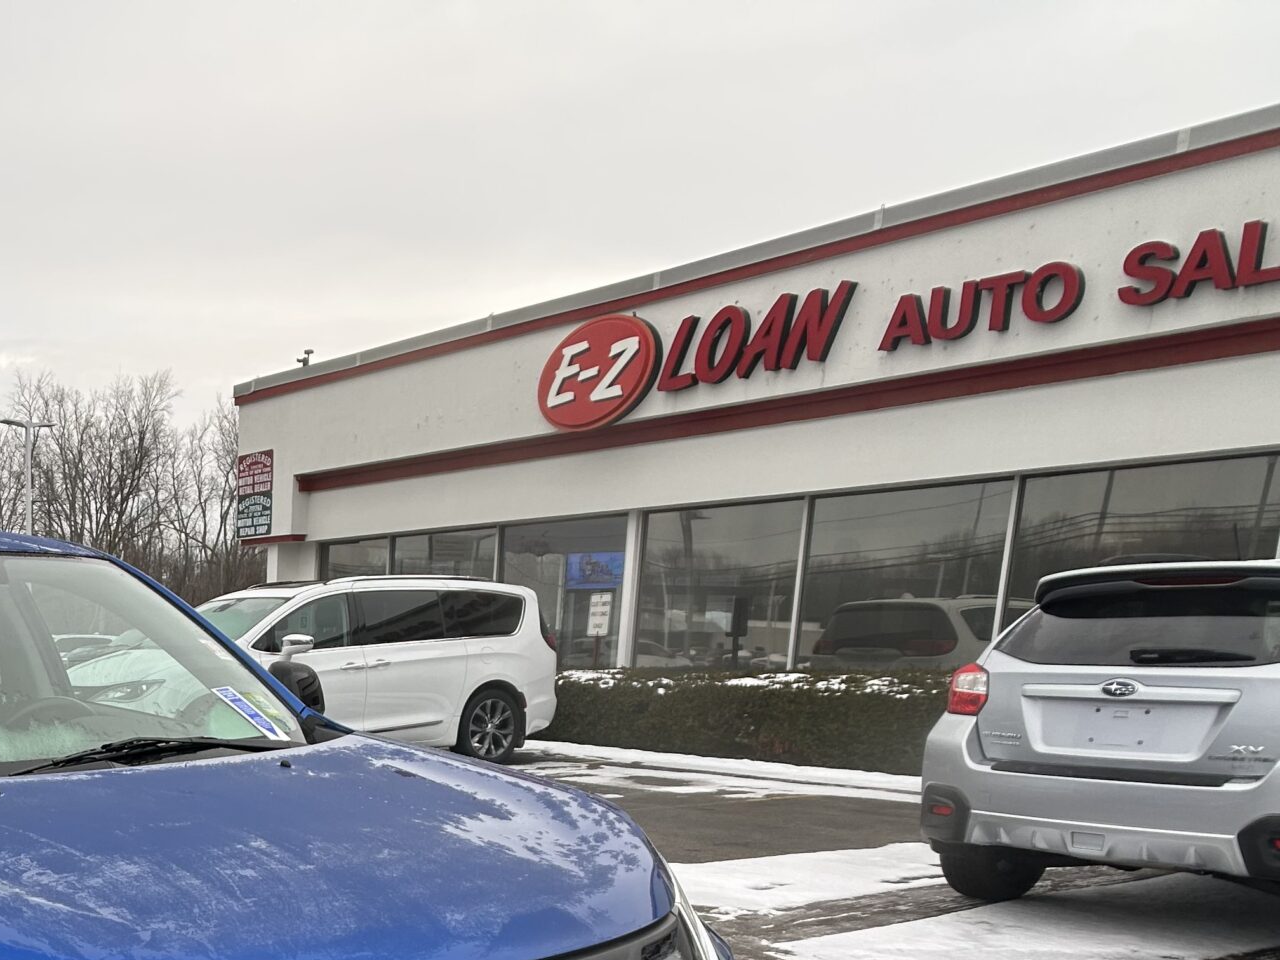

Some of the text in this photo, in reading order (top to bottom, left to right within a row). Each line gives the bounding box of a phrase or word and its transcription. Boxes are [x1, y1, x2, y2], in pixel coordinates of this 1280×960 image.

[547, 219, 1280, 408] E-Z LOAN AUTO SAL
[240, 453, 271, 471] REGISTERED
[254, 472, 271, 482] VEHICLE
[254, 482, 270, 492] DEALER
[239, 496, 271, 510] REGISTERED
[253, 515, 270, 525] VEHICLE
[240, 525, 268, 535] REPAIR SHOP
[1229, 744, 1265, 754] XV
